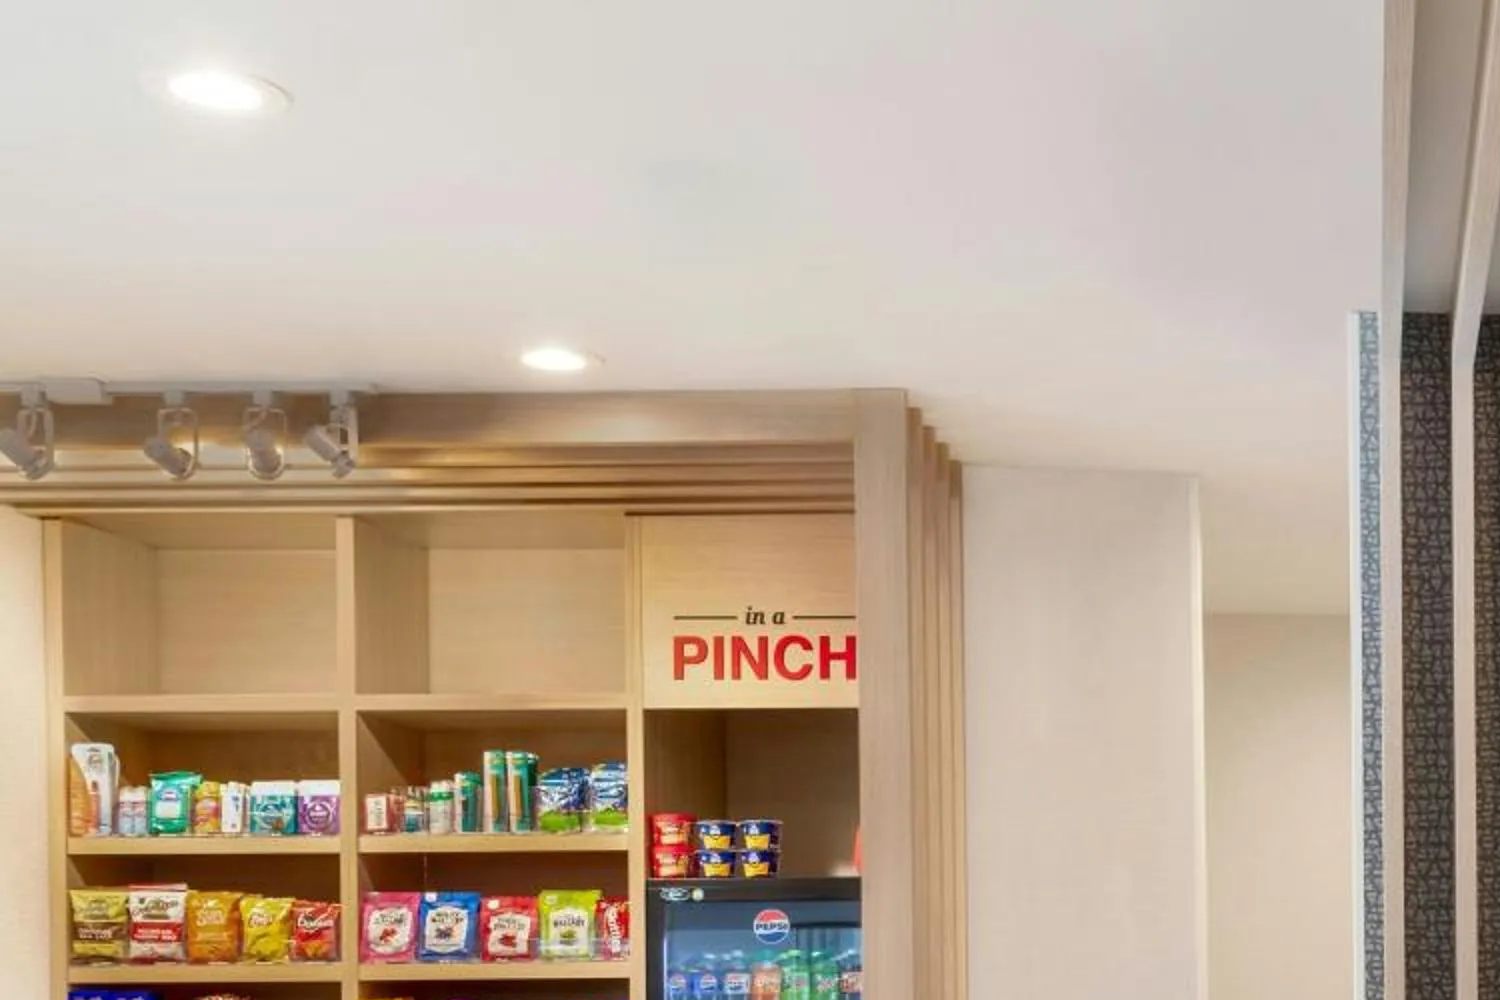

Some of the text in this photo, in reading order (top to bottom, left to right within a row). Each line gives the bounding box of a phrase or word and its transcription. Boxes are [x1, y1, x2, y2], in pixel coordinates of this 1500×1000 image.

[744, 606, 786, 625] in a
[673, 635, 857, 681] PINCH
